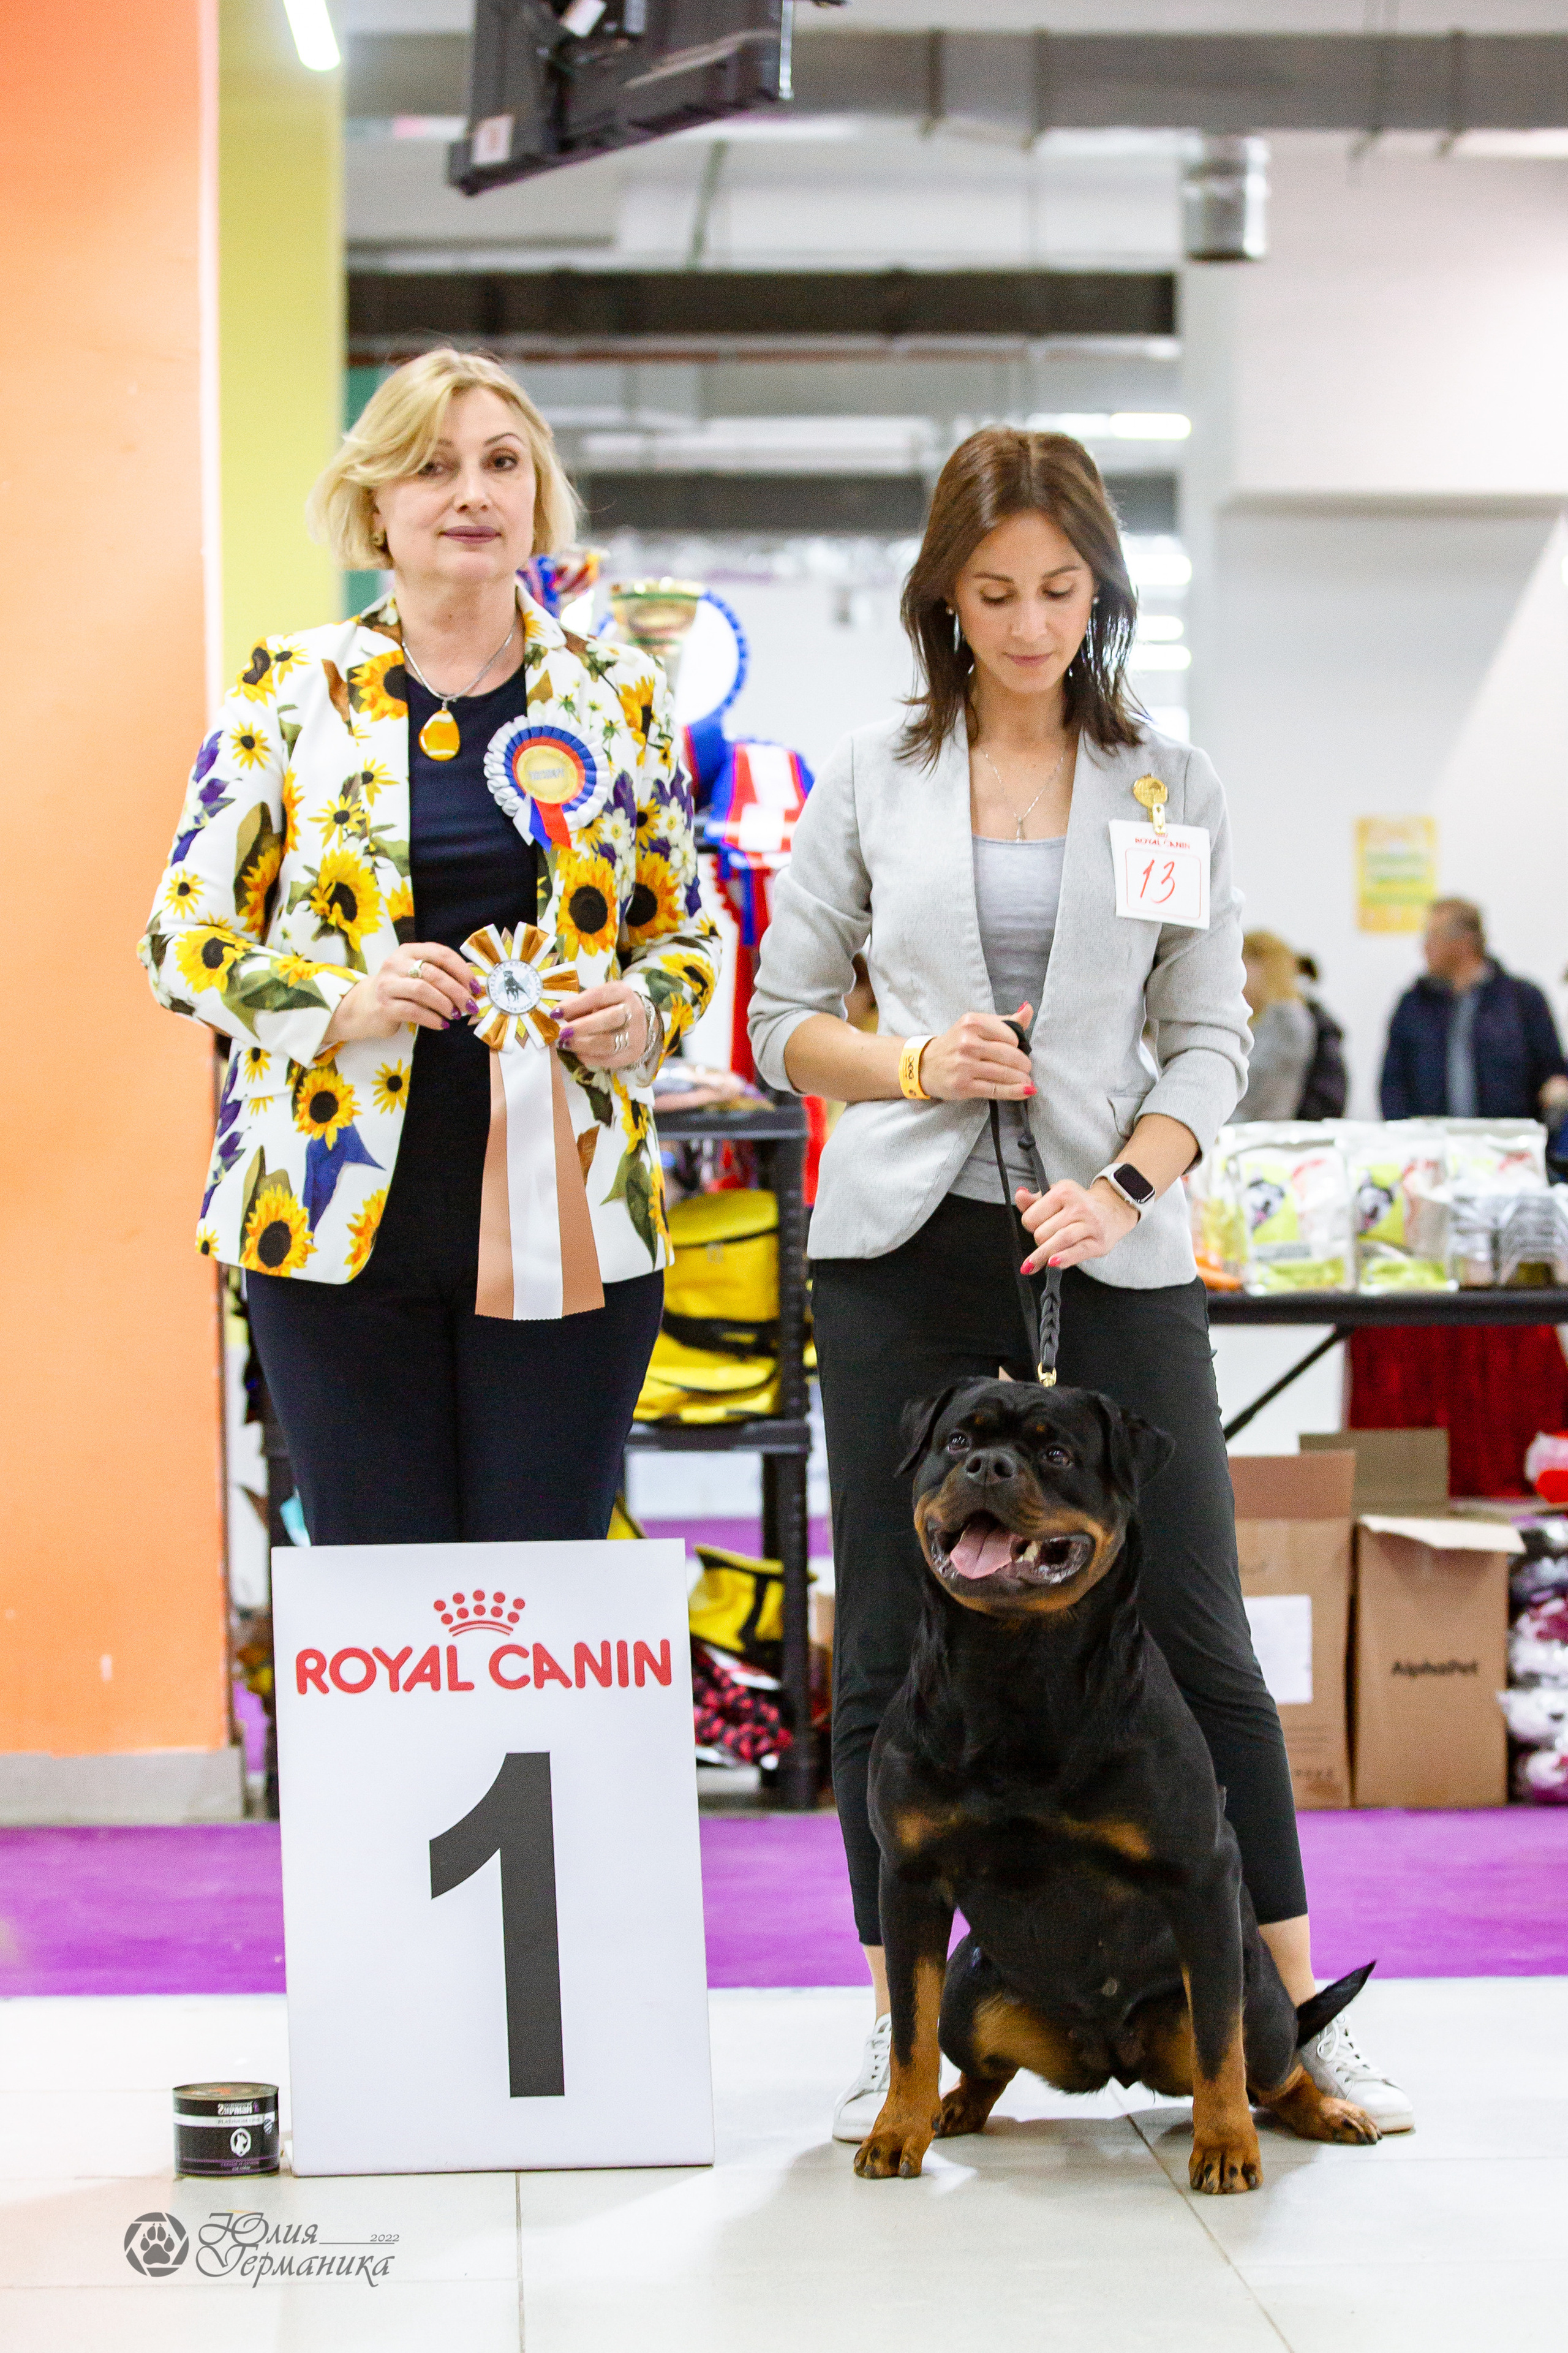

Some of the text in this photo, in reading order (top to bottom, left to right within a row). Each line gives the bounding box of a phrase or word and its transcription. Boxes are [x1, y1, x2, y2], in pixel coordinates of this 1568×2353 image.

[1139, 859, 1175, 904] 13
[295, 1638, 673, 1696] ROYAL CANIN
[429, 1751, 565, 2098] 1
